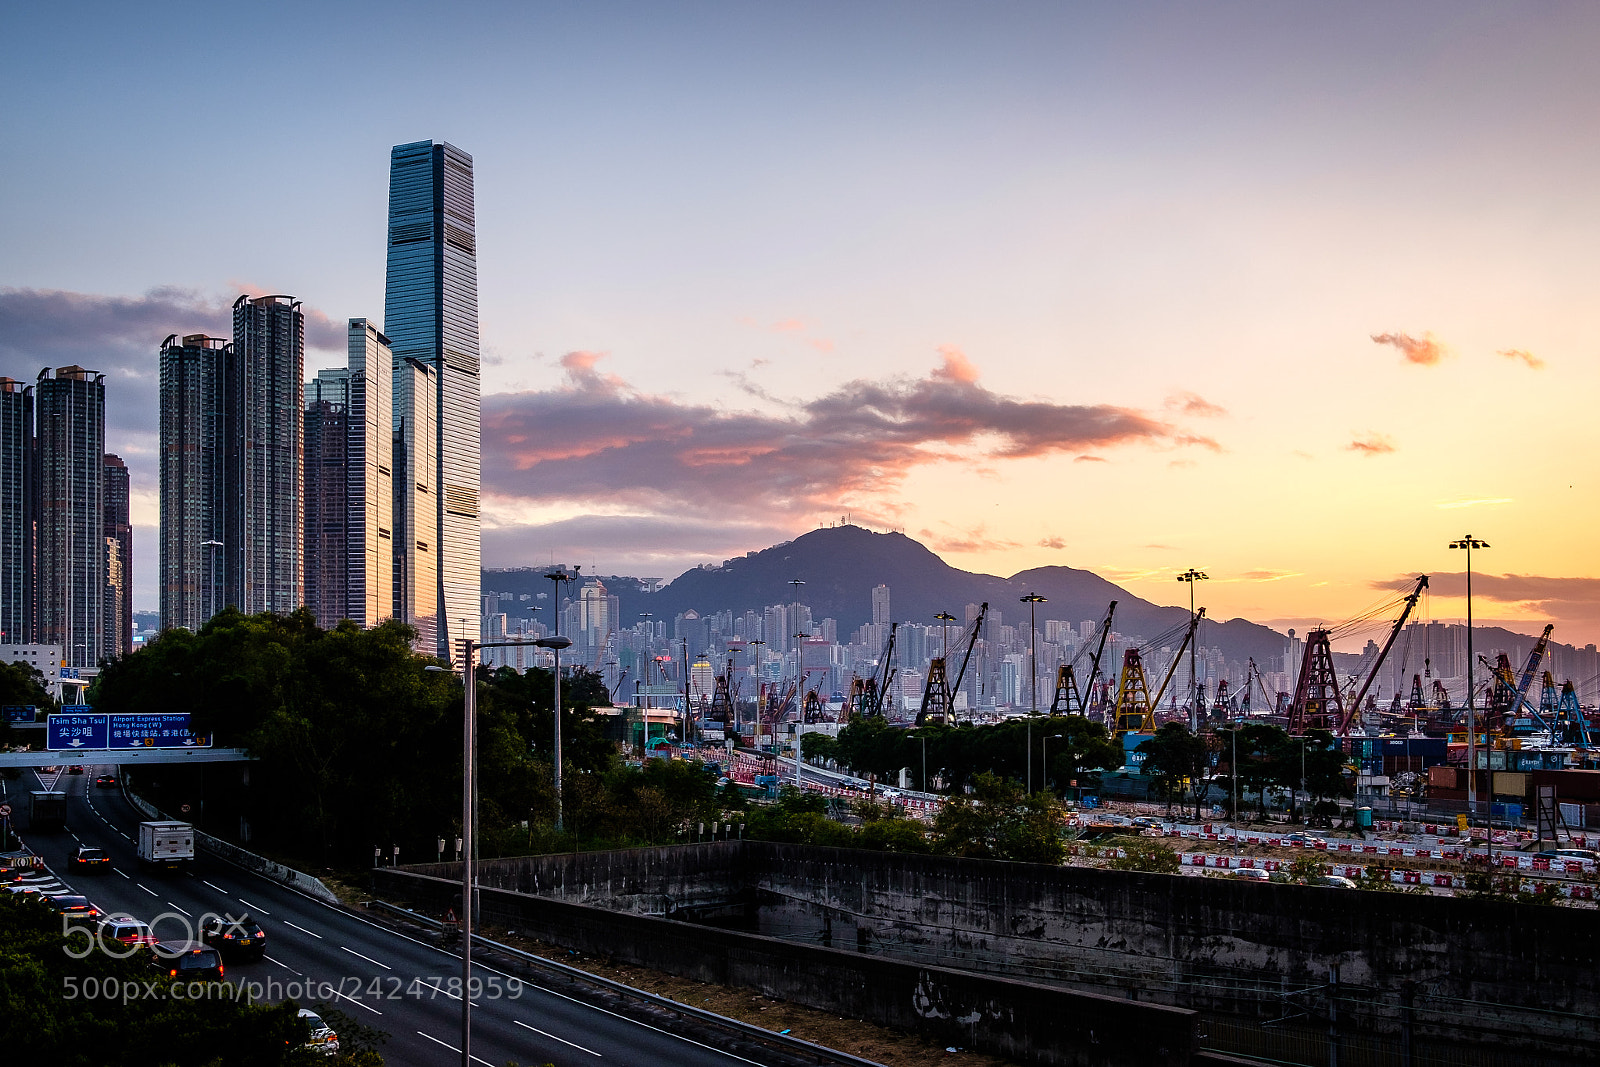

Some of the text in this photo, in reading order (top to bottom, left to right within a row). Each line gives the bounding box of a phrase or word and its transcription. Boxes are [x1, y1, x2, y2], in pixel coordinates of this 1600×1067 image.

[89, 716, 105, 724] Tsui
[59, 727, 93, 737] 尖沙咀
